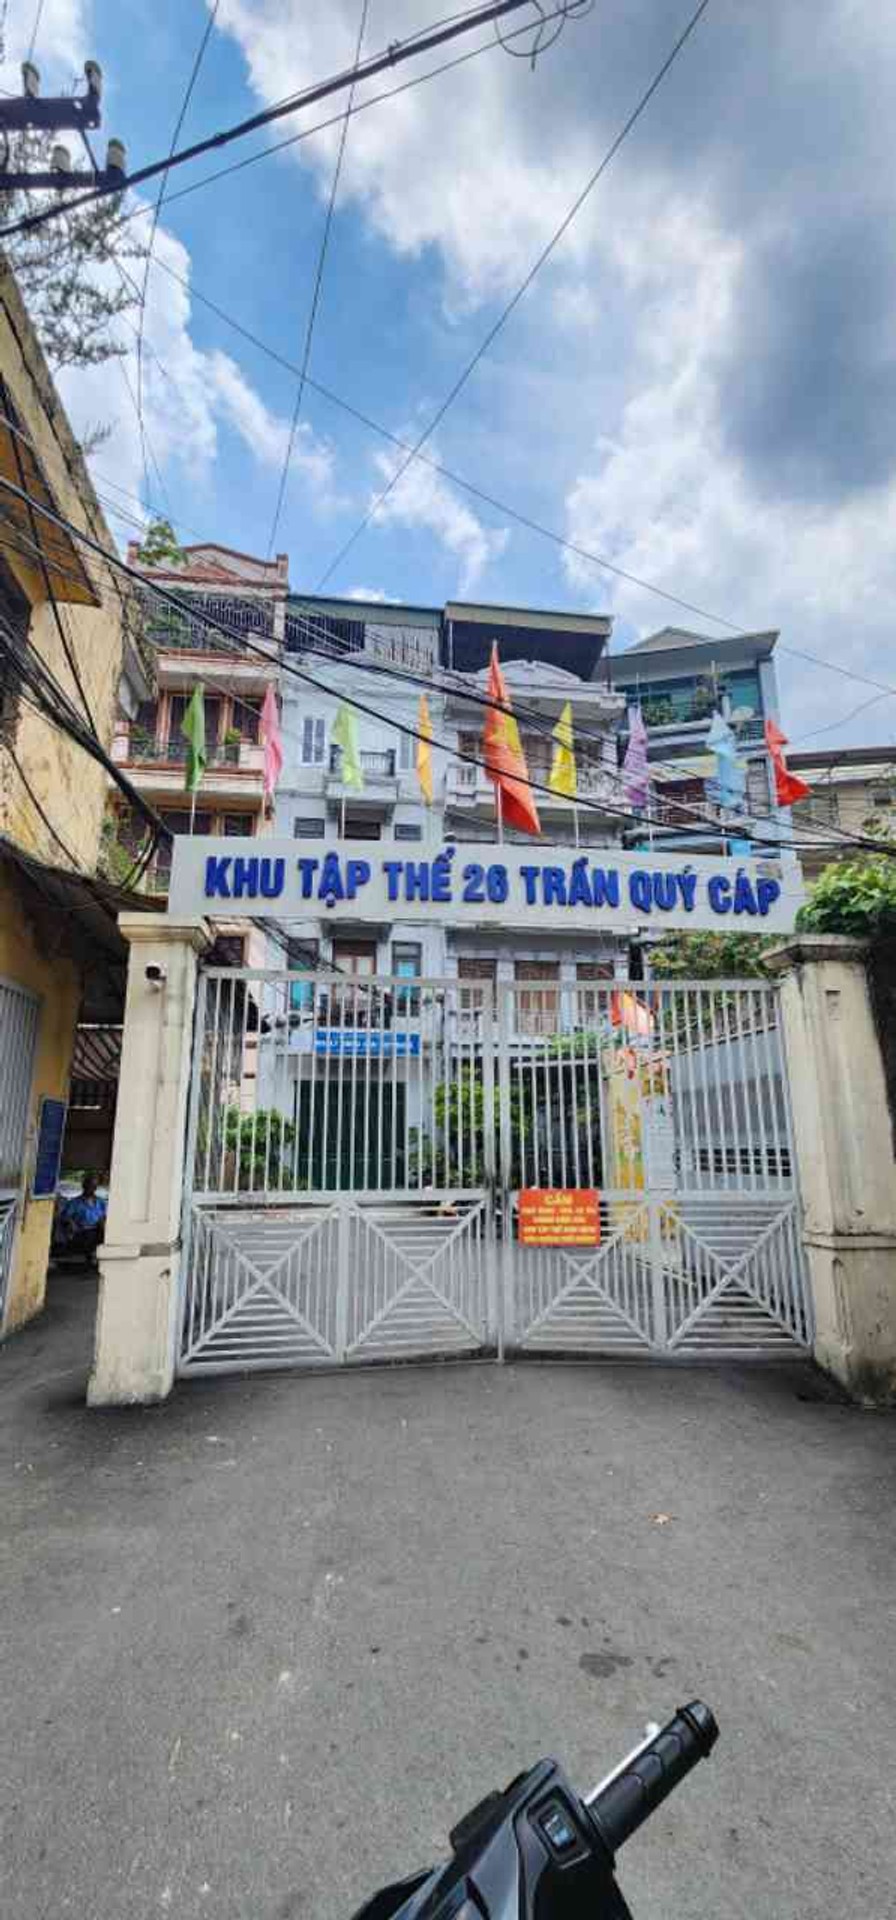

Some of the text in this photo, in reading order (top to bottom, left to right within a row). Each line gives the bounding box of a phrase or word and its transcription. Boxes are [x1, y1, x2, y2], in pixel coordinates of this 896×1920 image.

[205, 856, 286, 898] KHU
[299, 851, 371, 908] TẬP
[384, 846, 456, 903] THỂ
[463, 863, 508, 904] 26
[629, 865, 698, 914] QUÝ
[708, 867, 781, 915] CÁP
